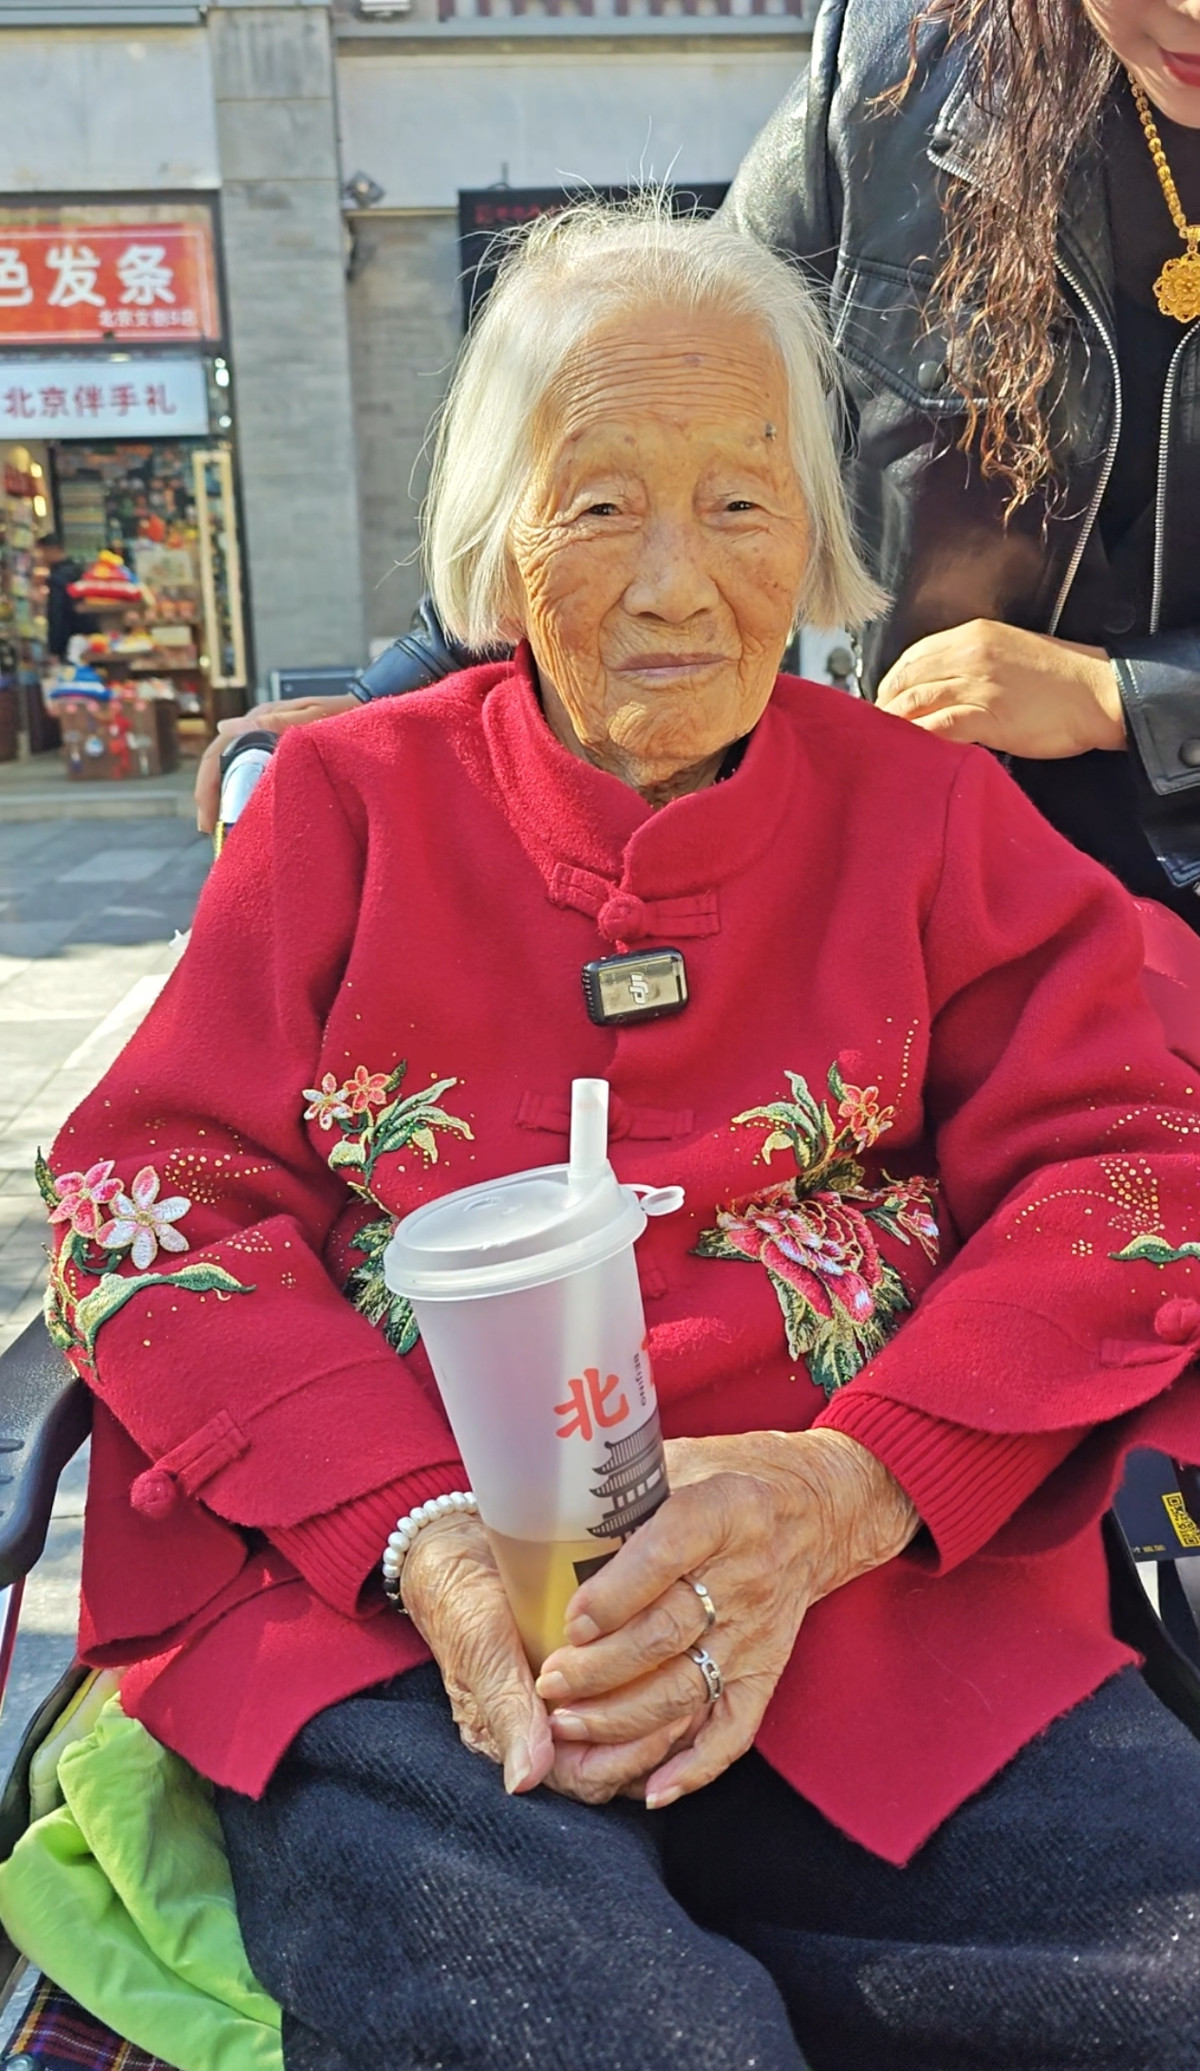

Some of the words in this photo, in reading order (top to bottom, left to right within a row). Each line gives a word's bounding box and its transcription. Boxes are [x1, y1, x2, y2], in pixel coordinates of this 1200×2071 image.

[4, 383, 177, 418] 北京伴手礼
[553, 1367, 630, 1442] 北
[633, 1353, 647, 1406] BEIJING
